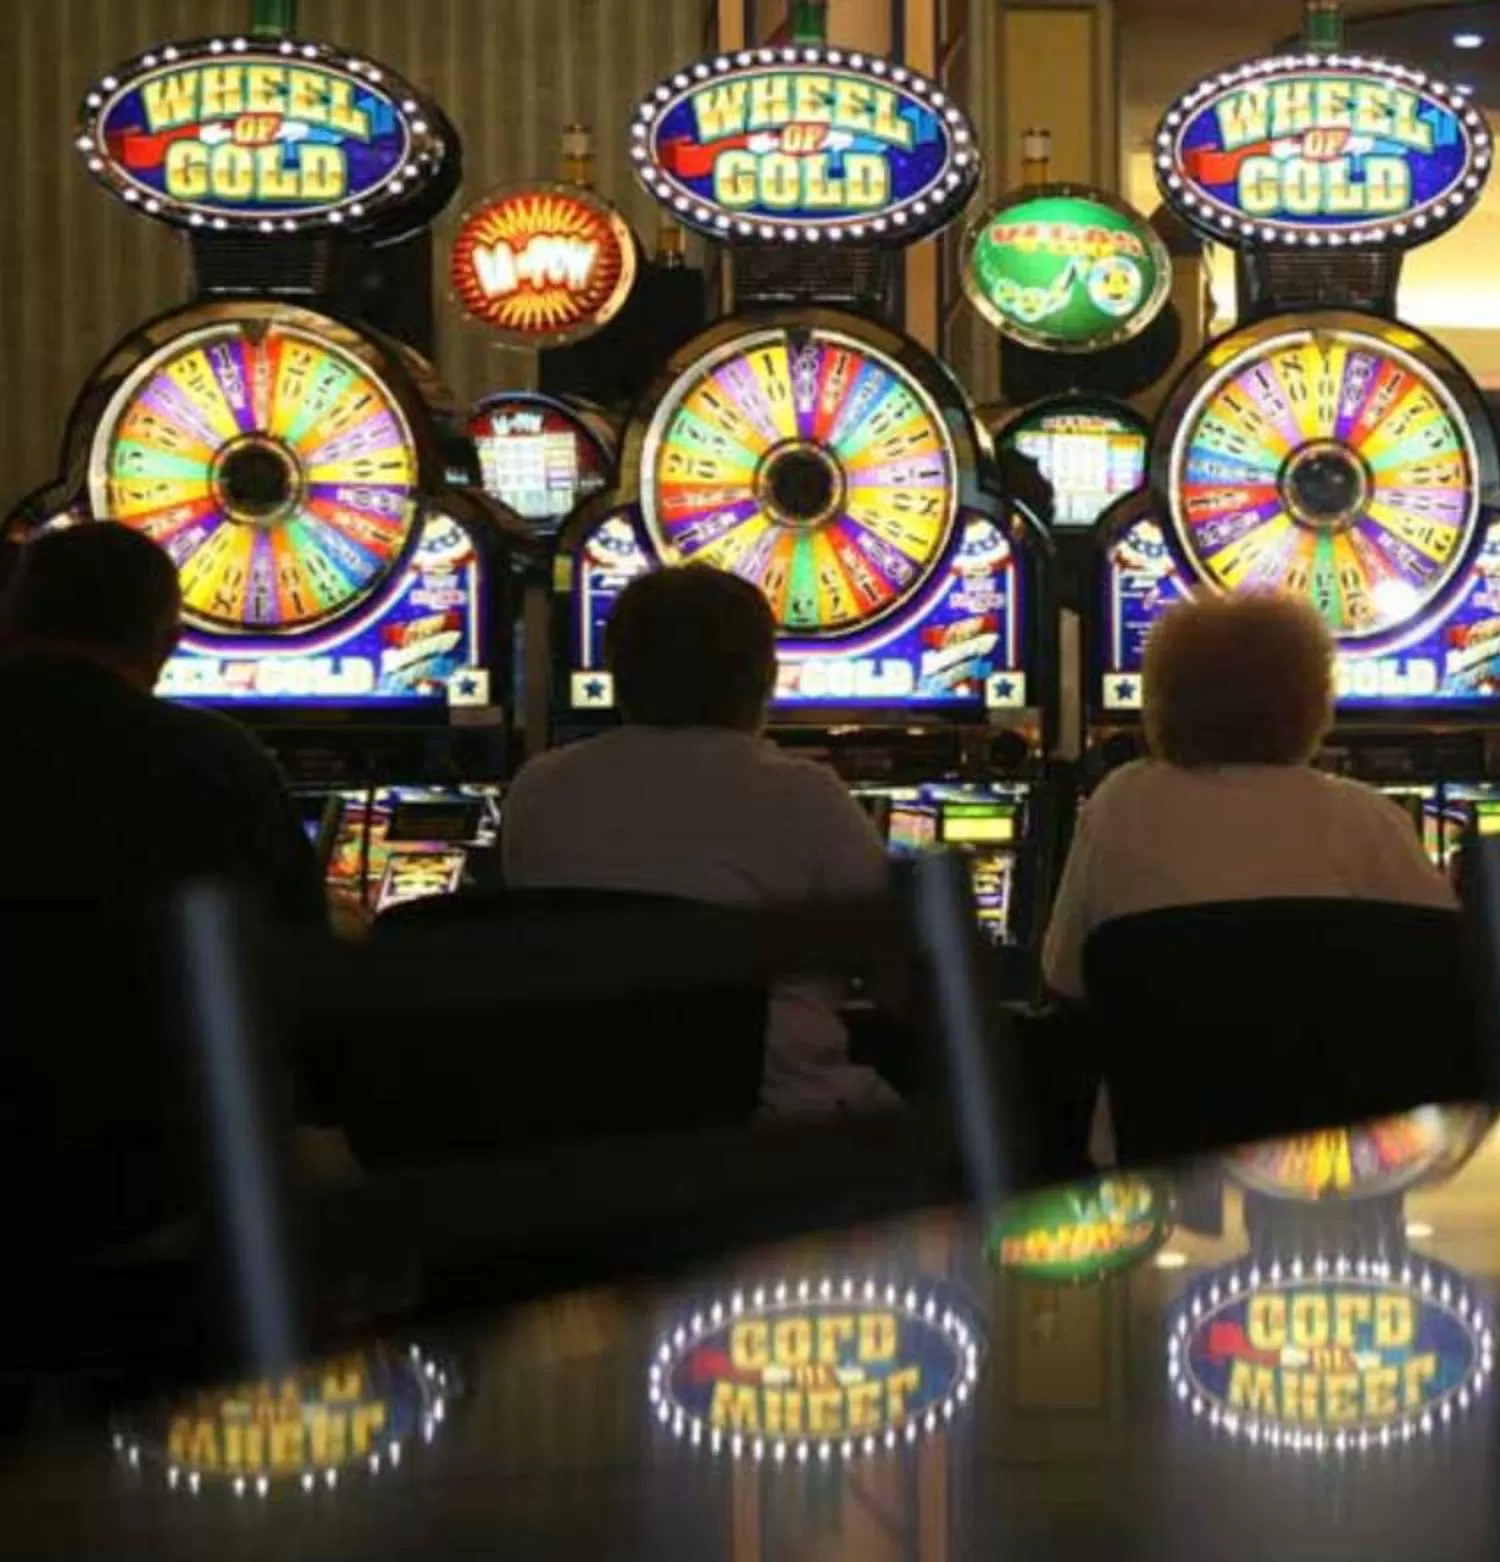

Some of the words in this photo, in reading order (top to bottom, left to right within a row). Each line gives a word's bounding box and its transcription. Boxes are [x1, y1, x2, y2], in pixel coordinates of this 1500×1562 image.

[142, 64, 371, 142] WHEEL
[232, 115, 276, 143] OF
[692, 74, 915, 149] WHEEL
[1215, 79, 1434, 153] WHEEL
[781, 124, 823, 153] OF
[1304, 129, 1346, 158] OF
[165, 140, 346, 200] GOLD
[712, 150, 890, 208] GOLD
[1238, 155, 1411, 215] GOLD
